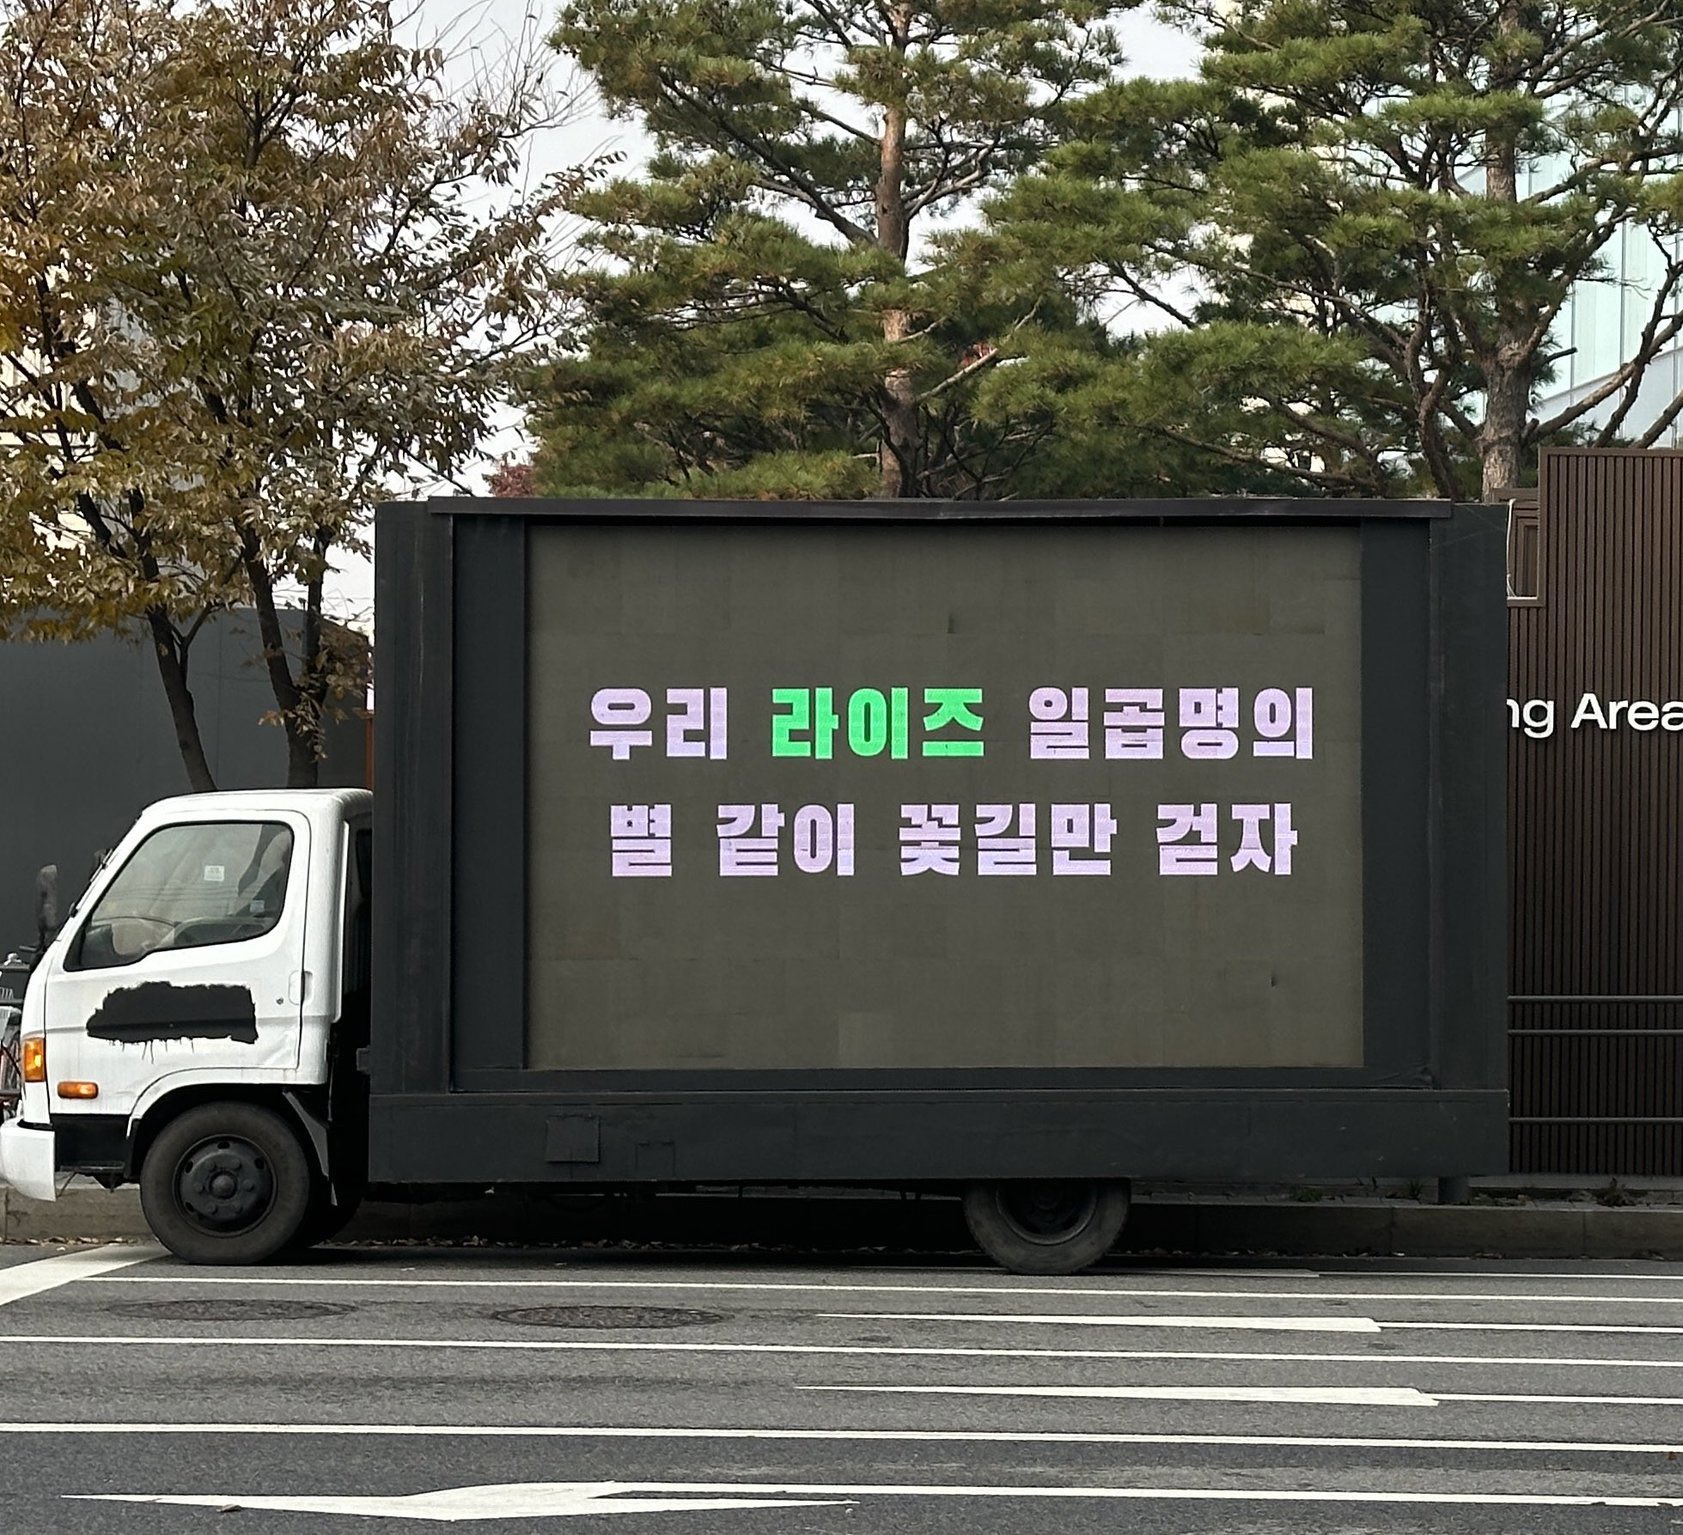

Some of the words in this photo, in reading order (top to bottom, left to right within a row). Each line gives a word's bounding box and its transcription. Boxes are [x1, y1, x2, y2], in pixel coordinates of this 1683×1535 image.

[590, 687, 728, 761] 우리
[771, 687, 985, 760] 라이즈
[1028, 687, 1313, 760] 일곱명의
[1570, 692, 1683, 731] Area
[610, 804, 673, 877] 별
[716, 803, 855, 877] 같이
[898, 803, 1118, 876] 꽃길만
[1156, 802, 1298, 876] 걷자
